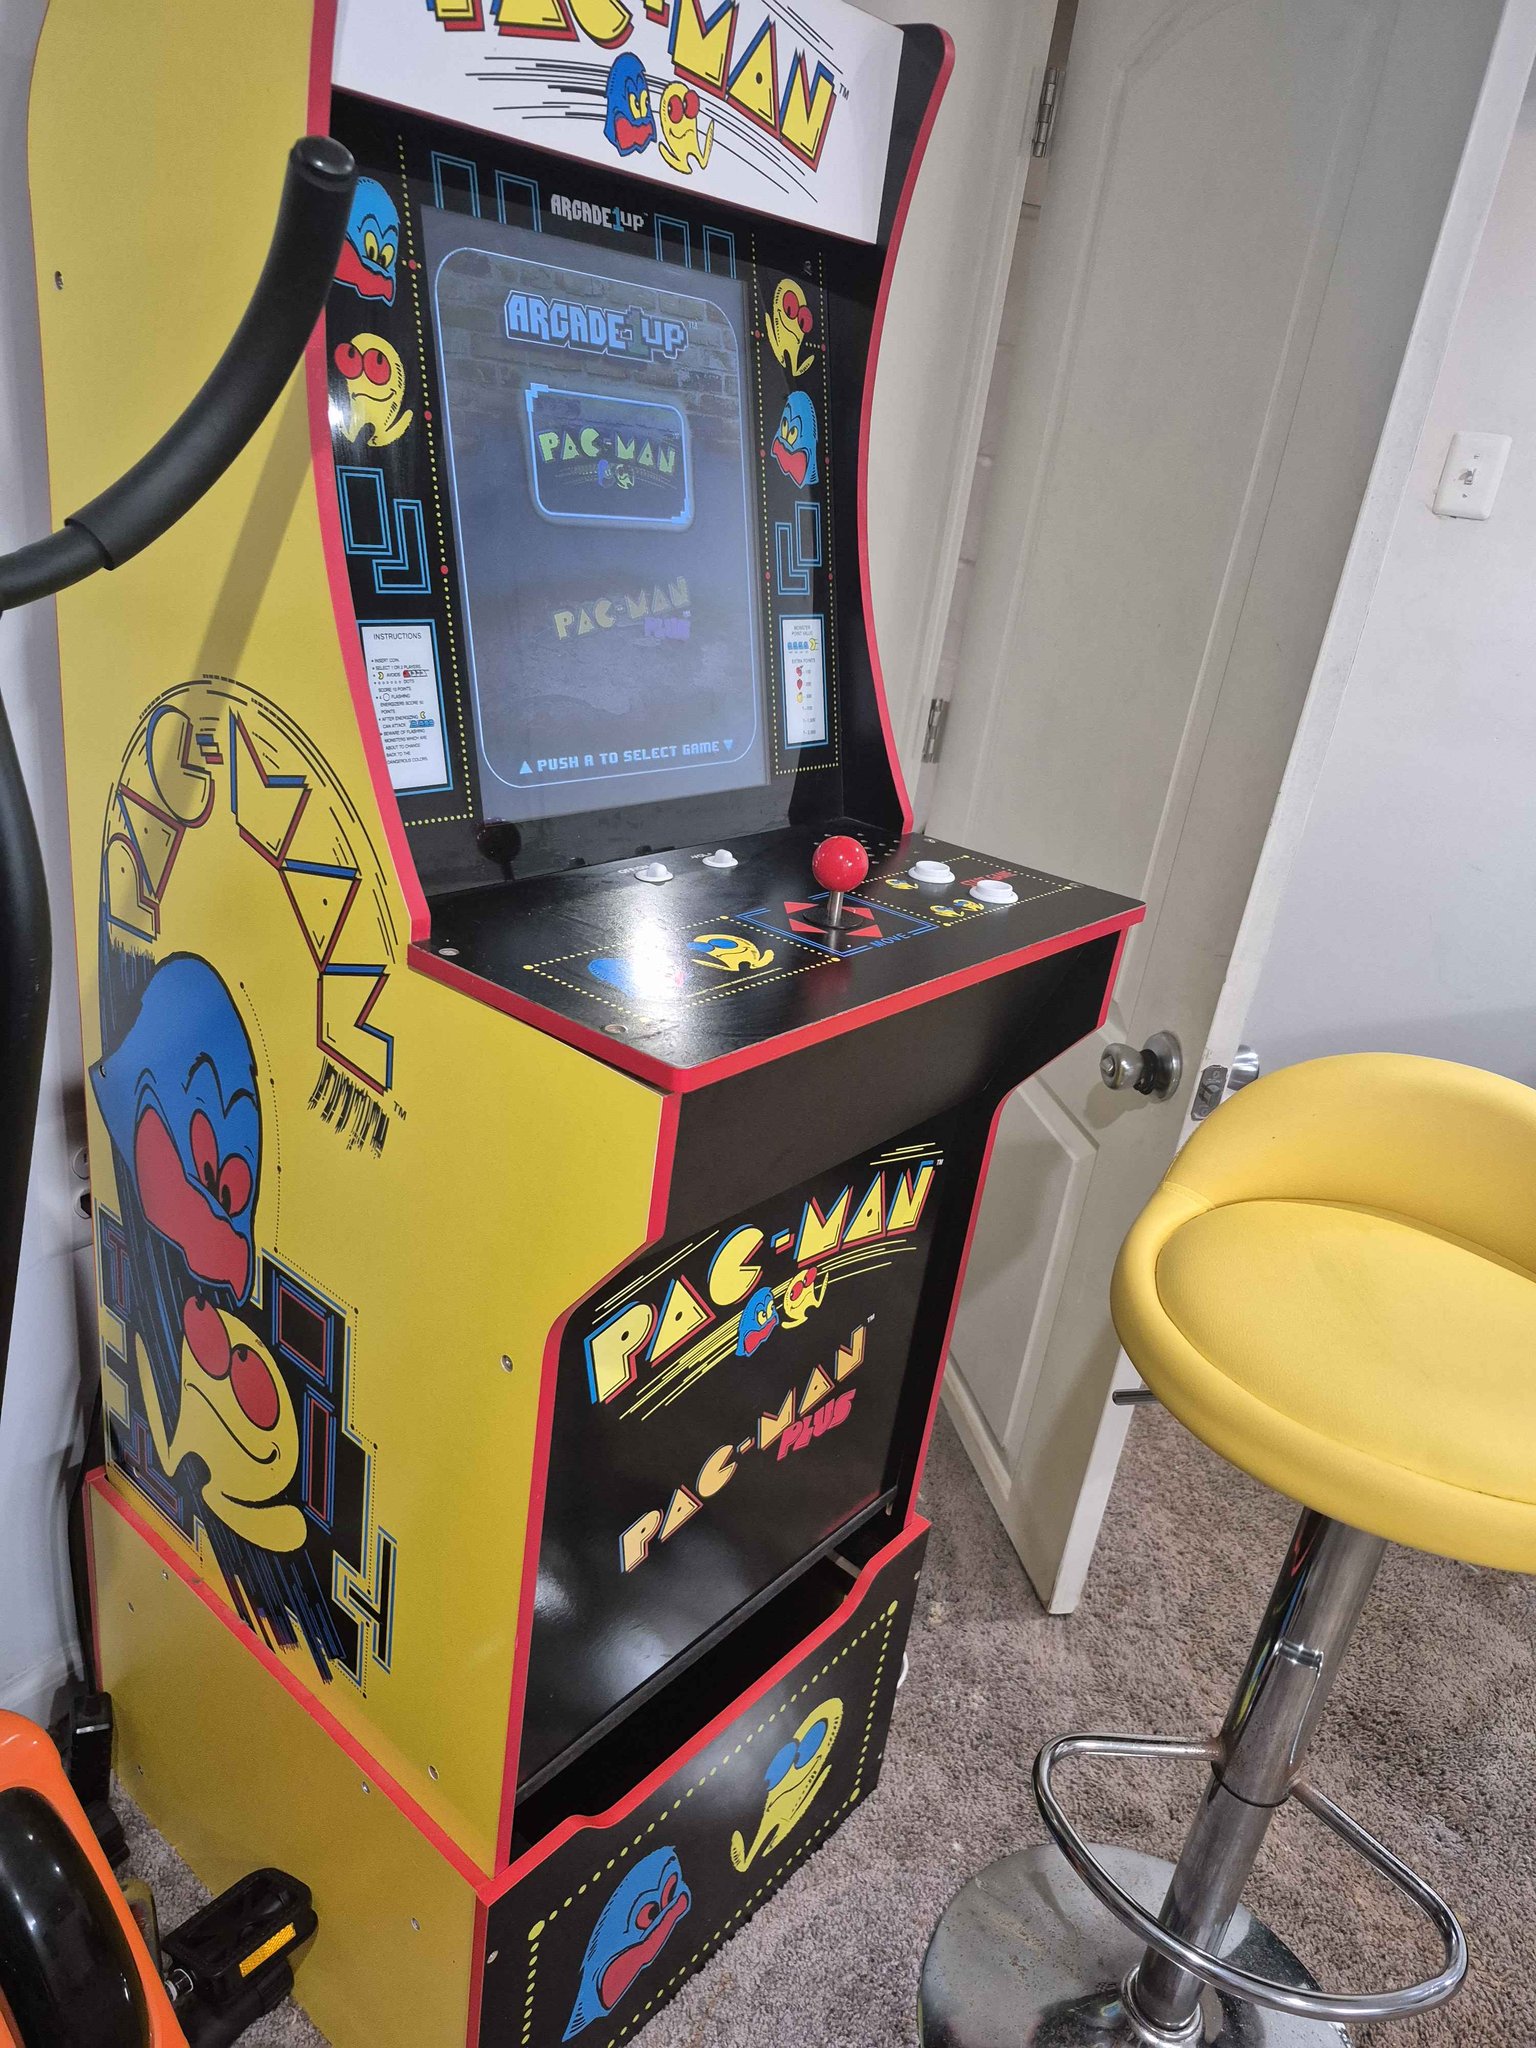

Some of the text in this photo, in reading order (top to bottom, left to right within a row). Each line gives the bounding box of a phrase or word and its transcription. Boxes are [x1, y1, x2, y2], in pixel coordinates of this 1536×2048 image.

[551, 194, 645, 232] ARCADE1UP
[537, 427, 676, 474] PAC-MAN
[373, 632, 422, 640] INSTRUCTIONS
[554, 576, 690, 641] PAC-MAN
[537, 741, 720, 772] PUSH A TO SELECT GAME
[101, 705, 396, 1097] PAC-MAN
[870, 932, 911, 948] MOVE
[583, 1159, 936, 1404] PAC-MAN
[619, 1325, 866, 1574] PAC-MAN
[776, 1388, 857, 1462] PLUS
